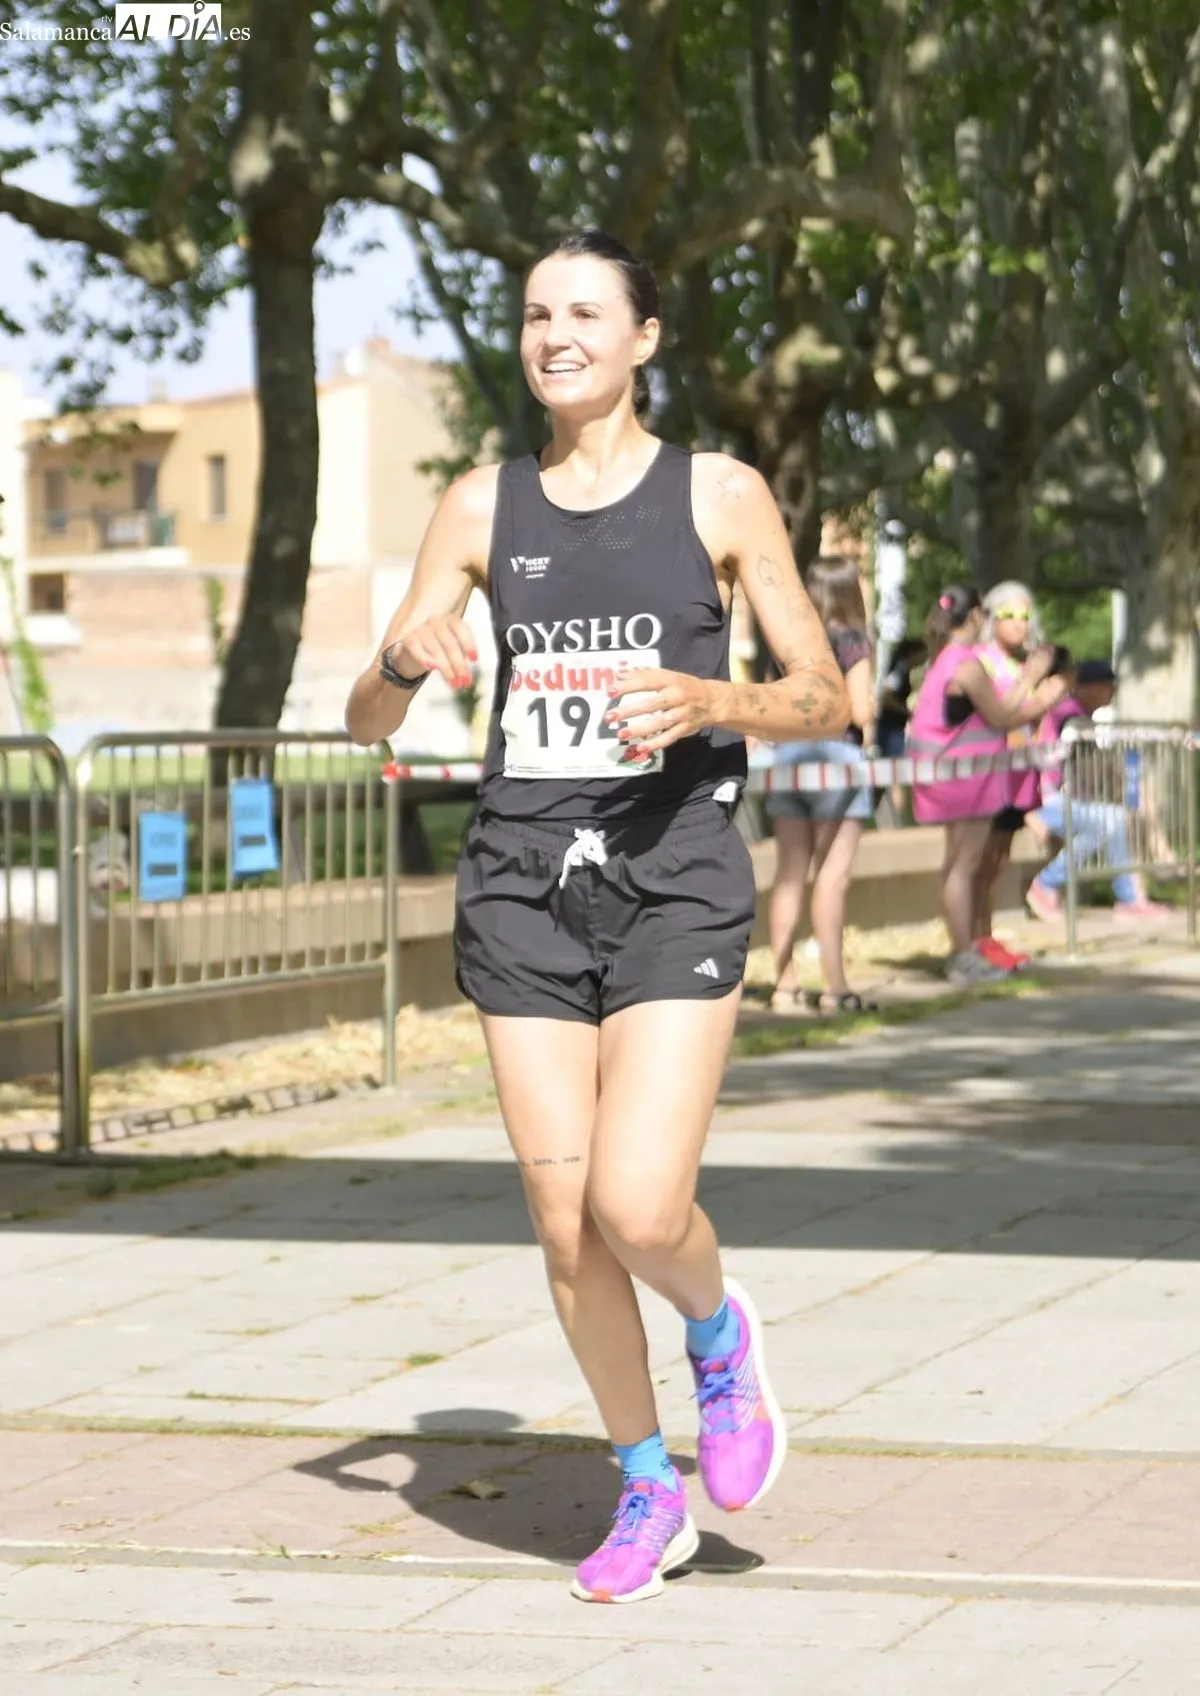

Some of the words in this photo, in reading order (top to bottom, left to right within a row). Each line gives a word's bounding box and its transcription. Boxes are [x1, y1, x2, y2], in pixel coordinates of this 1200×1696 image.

[506, 613, 662, 655] OYSHO
[510, 661, 650, 692] edun
[527, 695, 630, 748] 194
